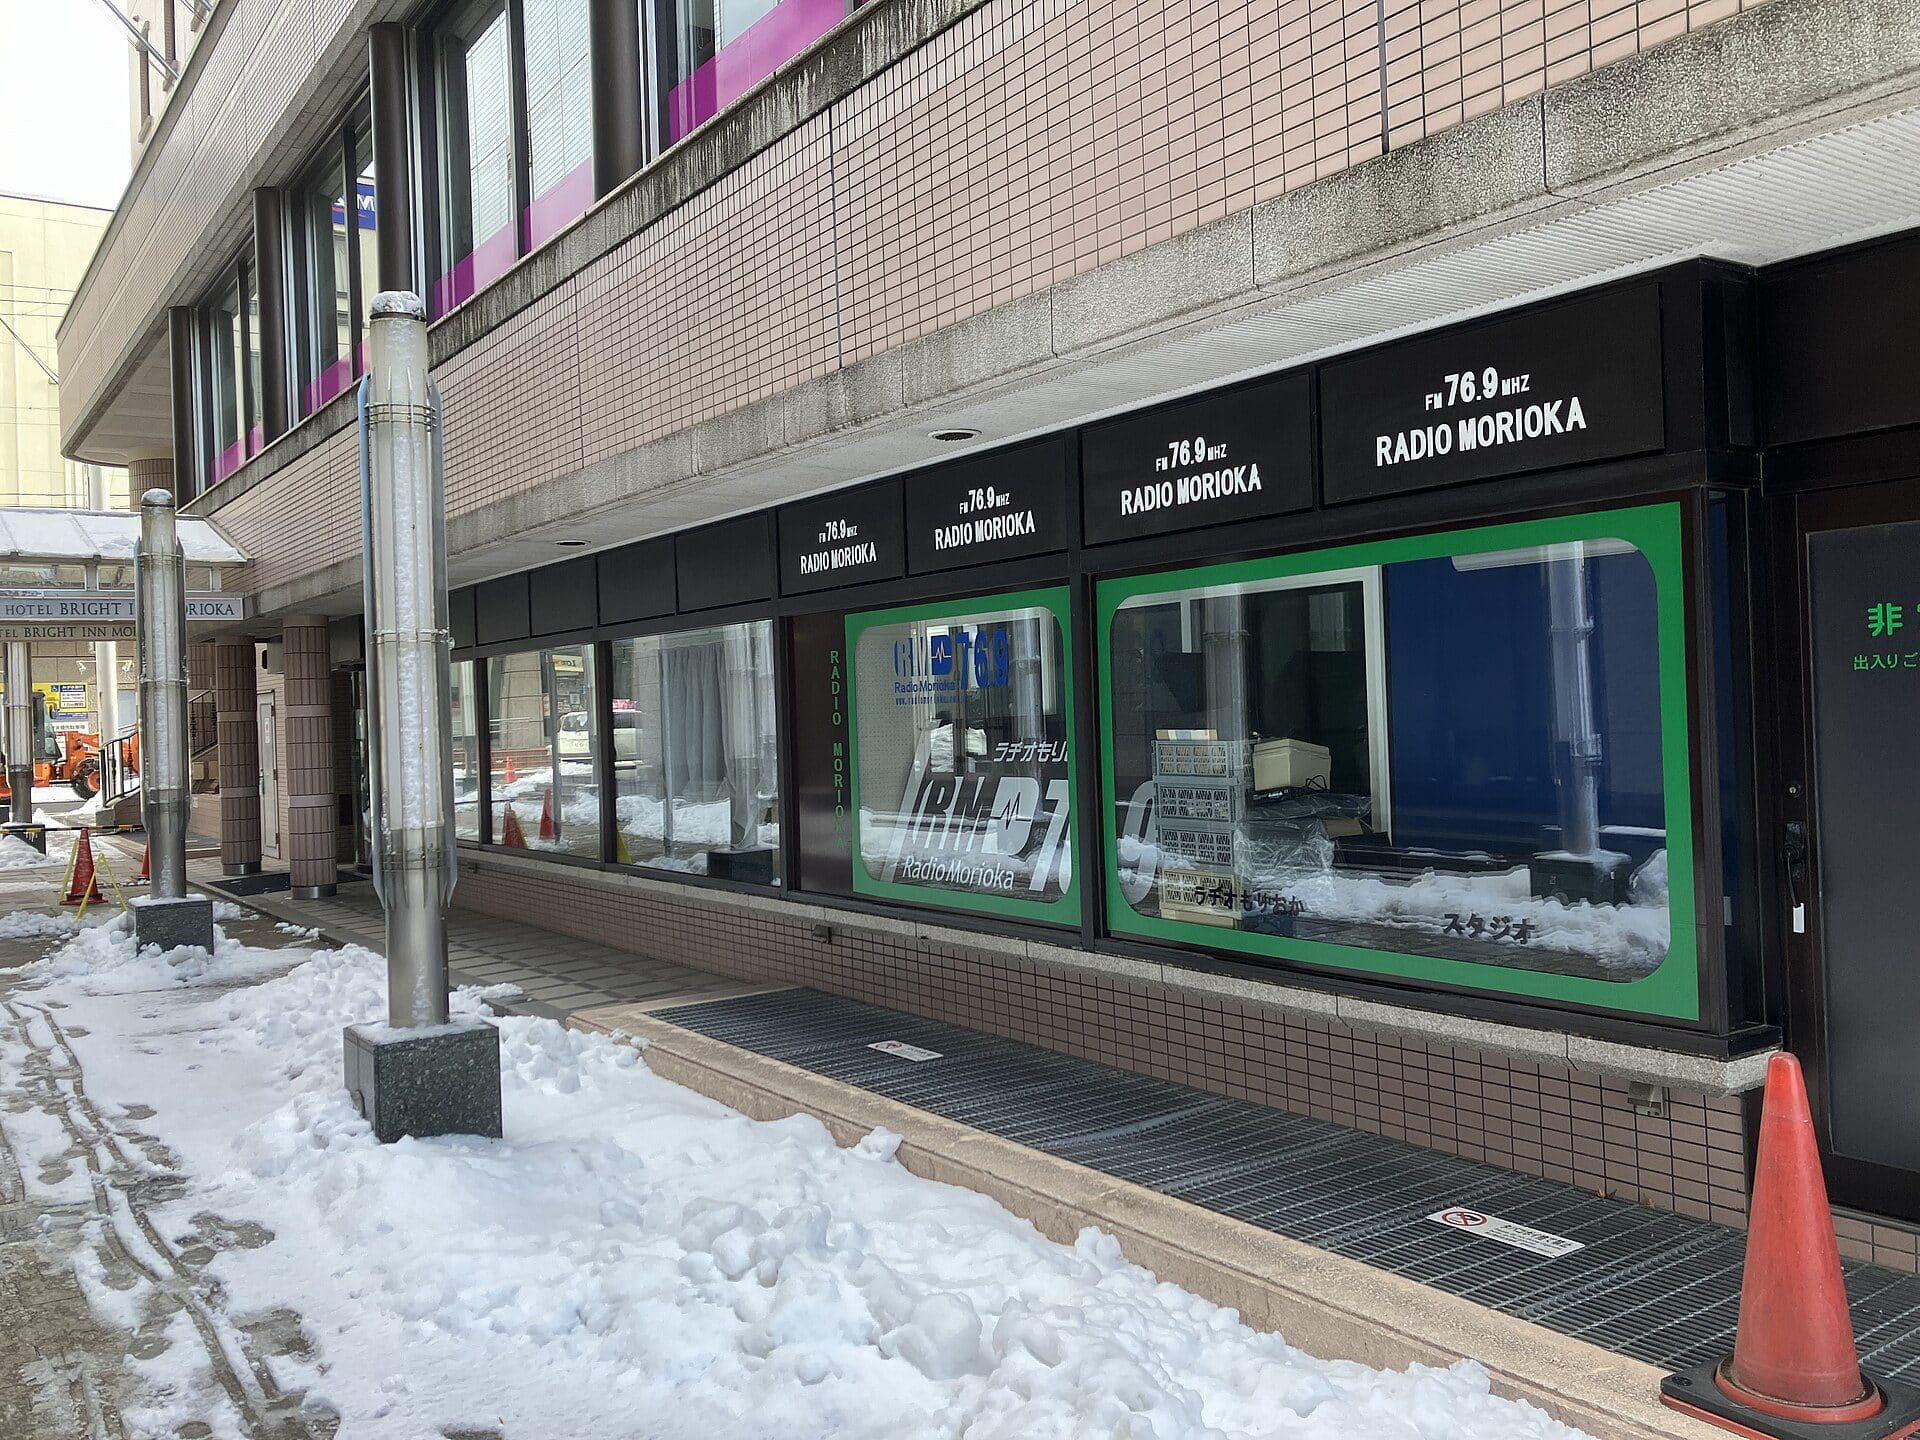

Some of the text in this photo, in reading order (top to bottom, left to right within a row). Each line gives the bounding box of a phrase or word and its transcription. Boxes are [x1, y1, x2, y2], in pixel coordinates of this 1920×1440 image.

[1425, 392, 1443, 411] FM
[1444, 367, 1499, 407] 76.9
[1376, 396, 1587, 467] RADIO MORIOKA
[1169, 436, 1206, 469] 76.9
[968, 486, 995, 512] 76.9
[1121, 463, 1262, 516] RADIO MORIOKA
[825, 519, 846, 541] 76.9
[934, 510, 1036, 551] RADIO MORIOKA
[800, 541, 877, 575] RADIO MORIOKA
[5, 603, 53, 615] HOTEL
[60, 602, 122, 615] BRIGHT
[185, 603, 235, 615] RIOKA
[1867, 602, 1920, 637] 非
[0, 626, 136, 638] TEL BRIGHT INN MO
[1853, 652, 1920, 671] 出入りご
[829, 650, 845, 848] RADIO MORIOKA
[993, 740, 1068, 762] ラヂオもり
[1443, 912, 1536, 945] スタジオ
